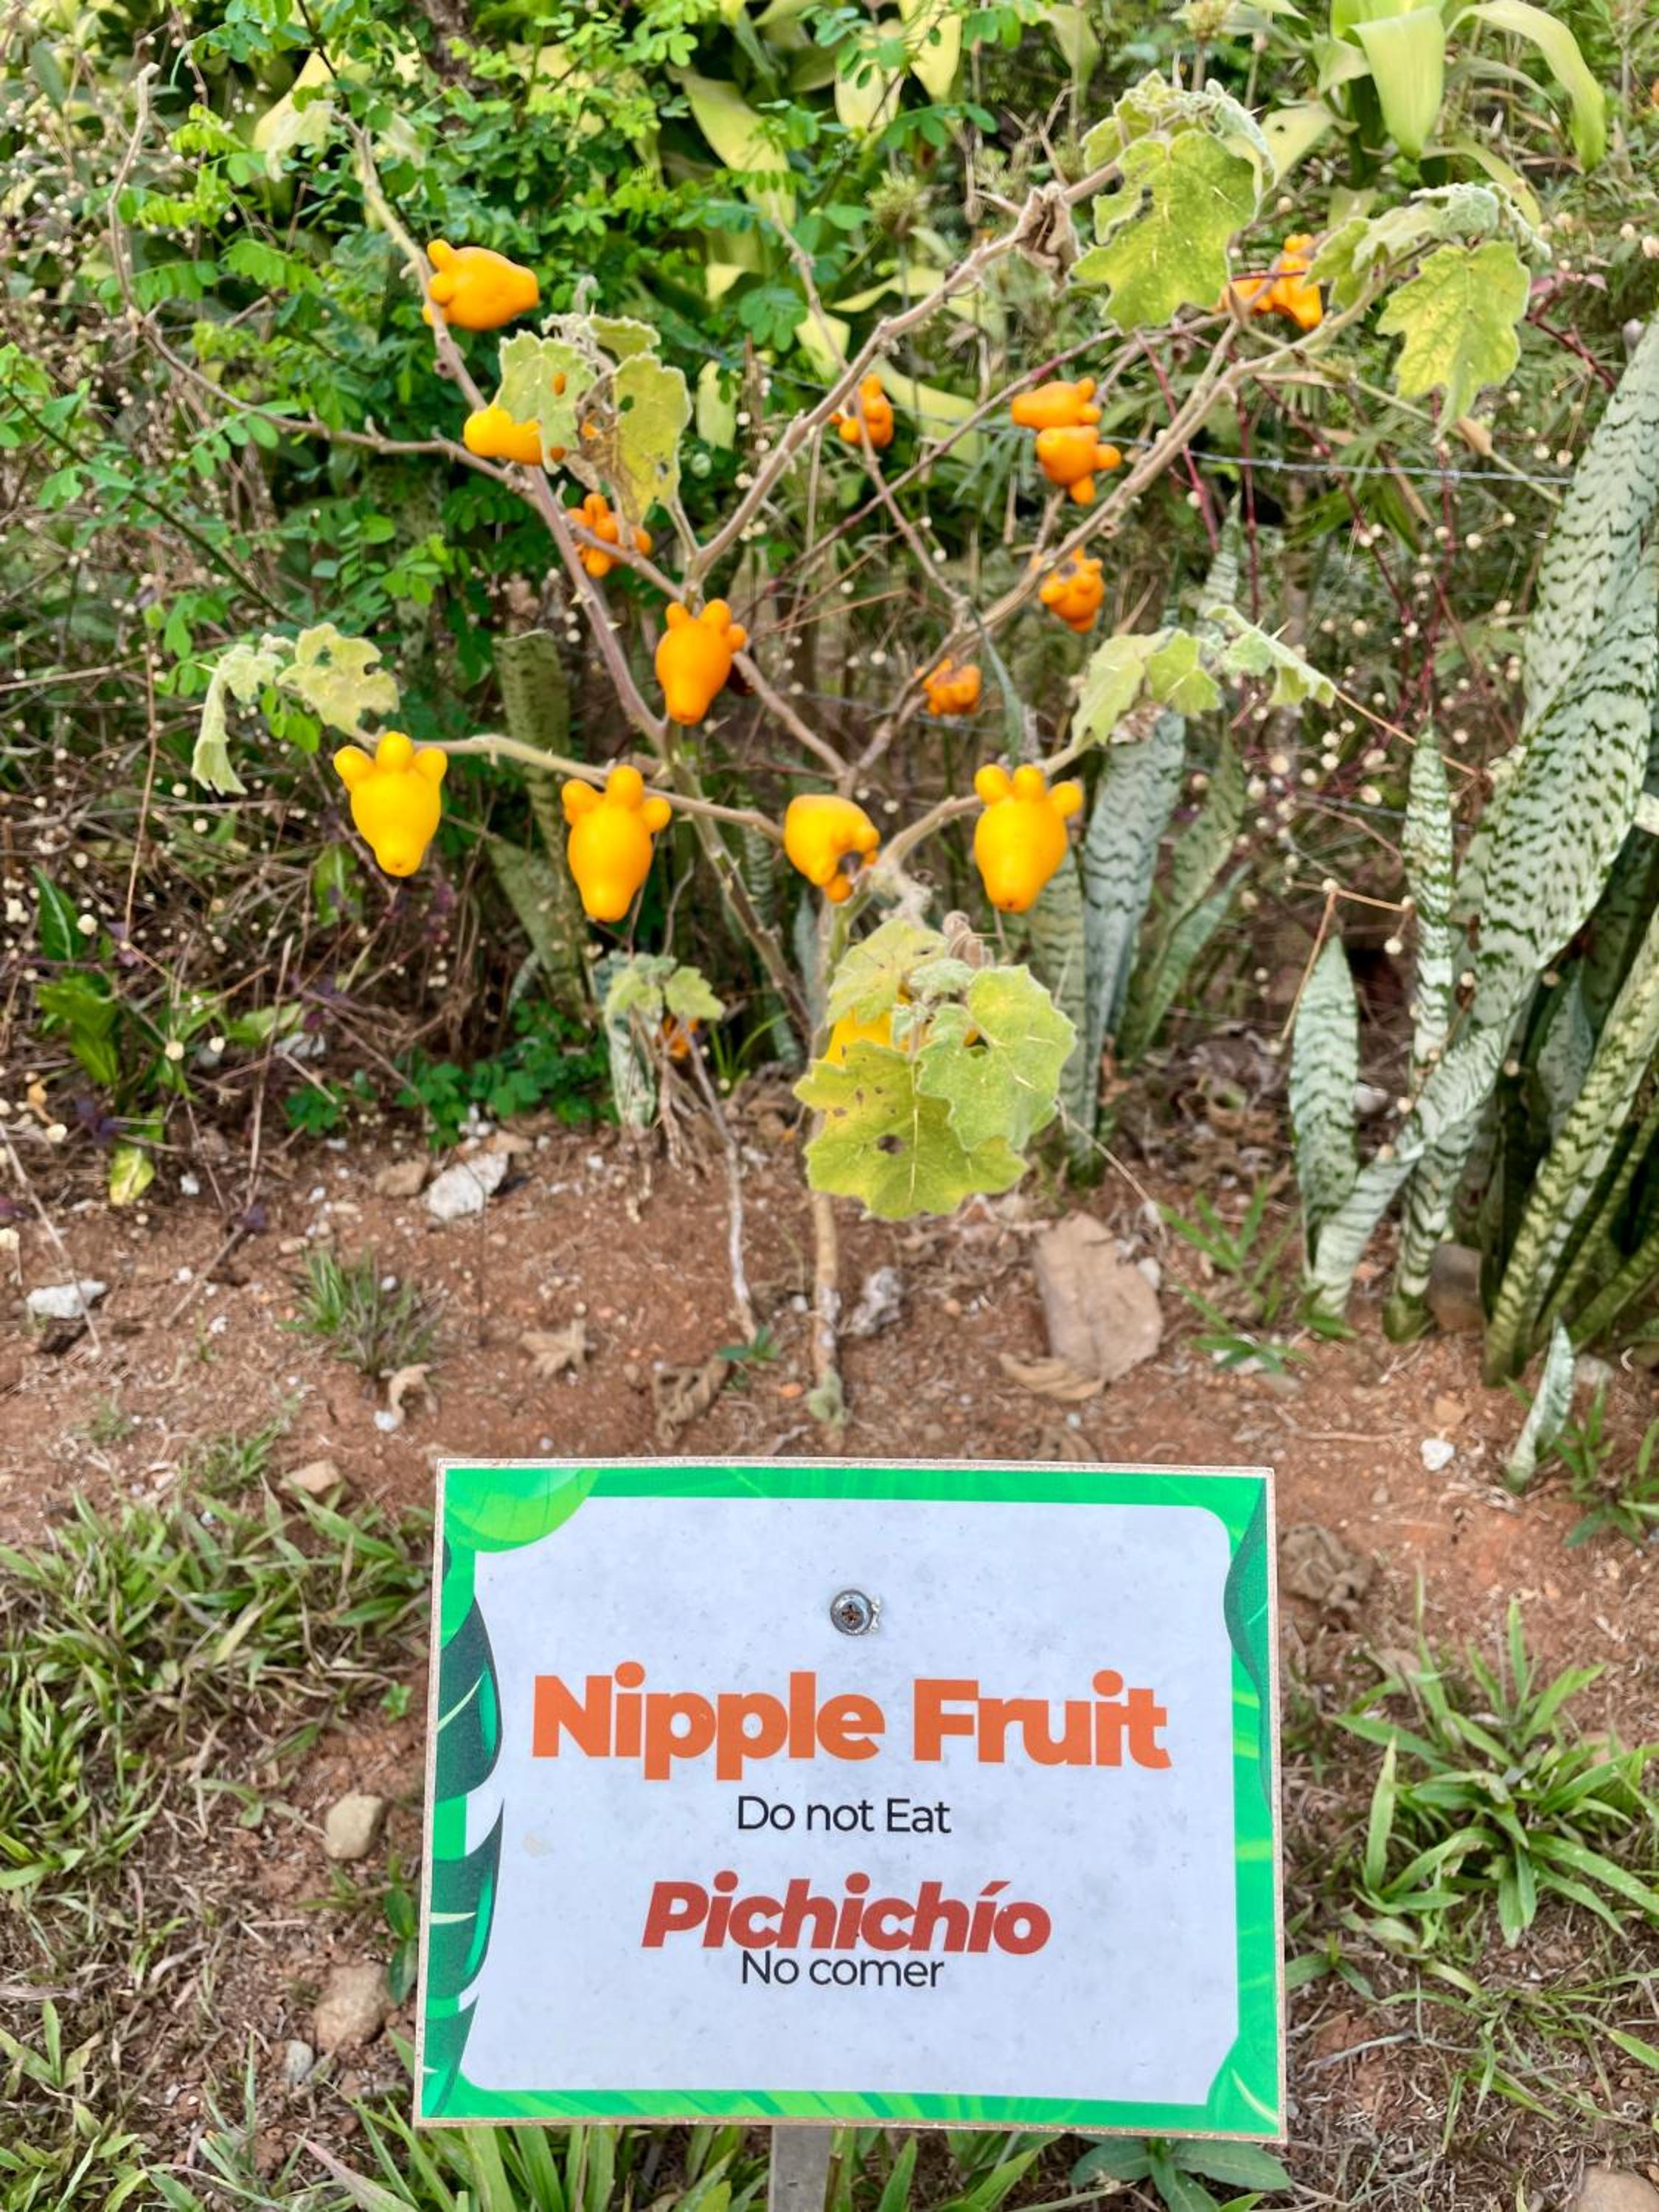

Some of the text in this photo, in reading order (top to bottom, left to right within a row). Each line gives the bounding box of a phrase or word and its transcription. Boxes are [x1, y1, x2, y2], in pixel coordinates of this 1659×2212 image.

[532, 1661, 1171, 1781] Nipple Fruit
[738, 1796, 952, 1834] Do not Eat
[641, 1871, 1051, 1955] Pichichío
[742, 1950, 945, 1988] No comer
